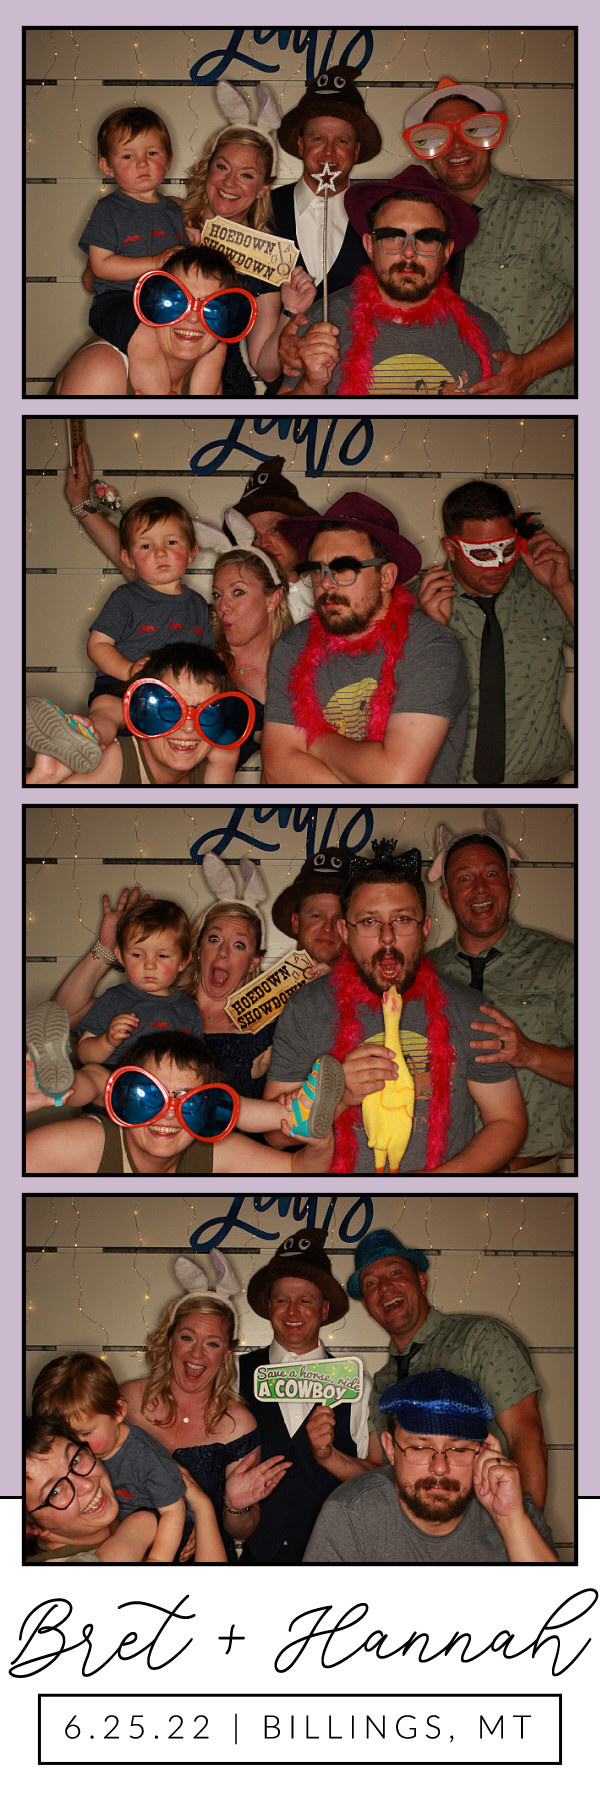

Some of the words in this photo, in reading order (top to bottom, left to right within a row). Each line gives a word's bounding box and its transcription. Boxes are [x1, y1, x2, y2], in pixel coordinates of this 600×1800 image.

[208, 223, 277, 255] HOEDOWN
[231, 965, 291, 1016] HOEDOWN
[257, 1367, 287, 1380] Save
[289, 1369, 298, 1378] a
[299, 1365, 334, 1384] horse,
[337, 1377, 361, 1392] ride
[258, 1380, 272, 1398] A
[274, 1378, 348, 1400] COWBOY
